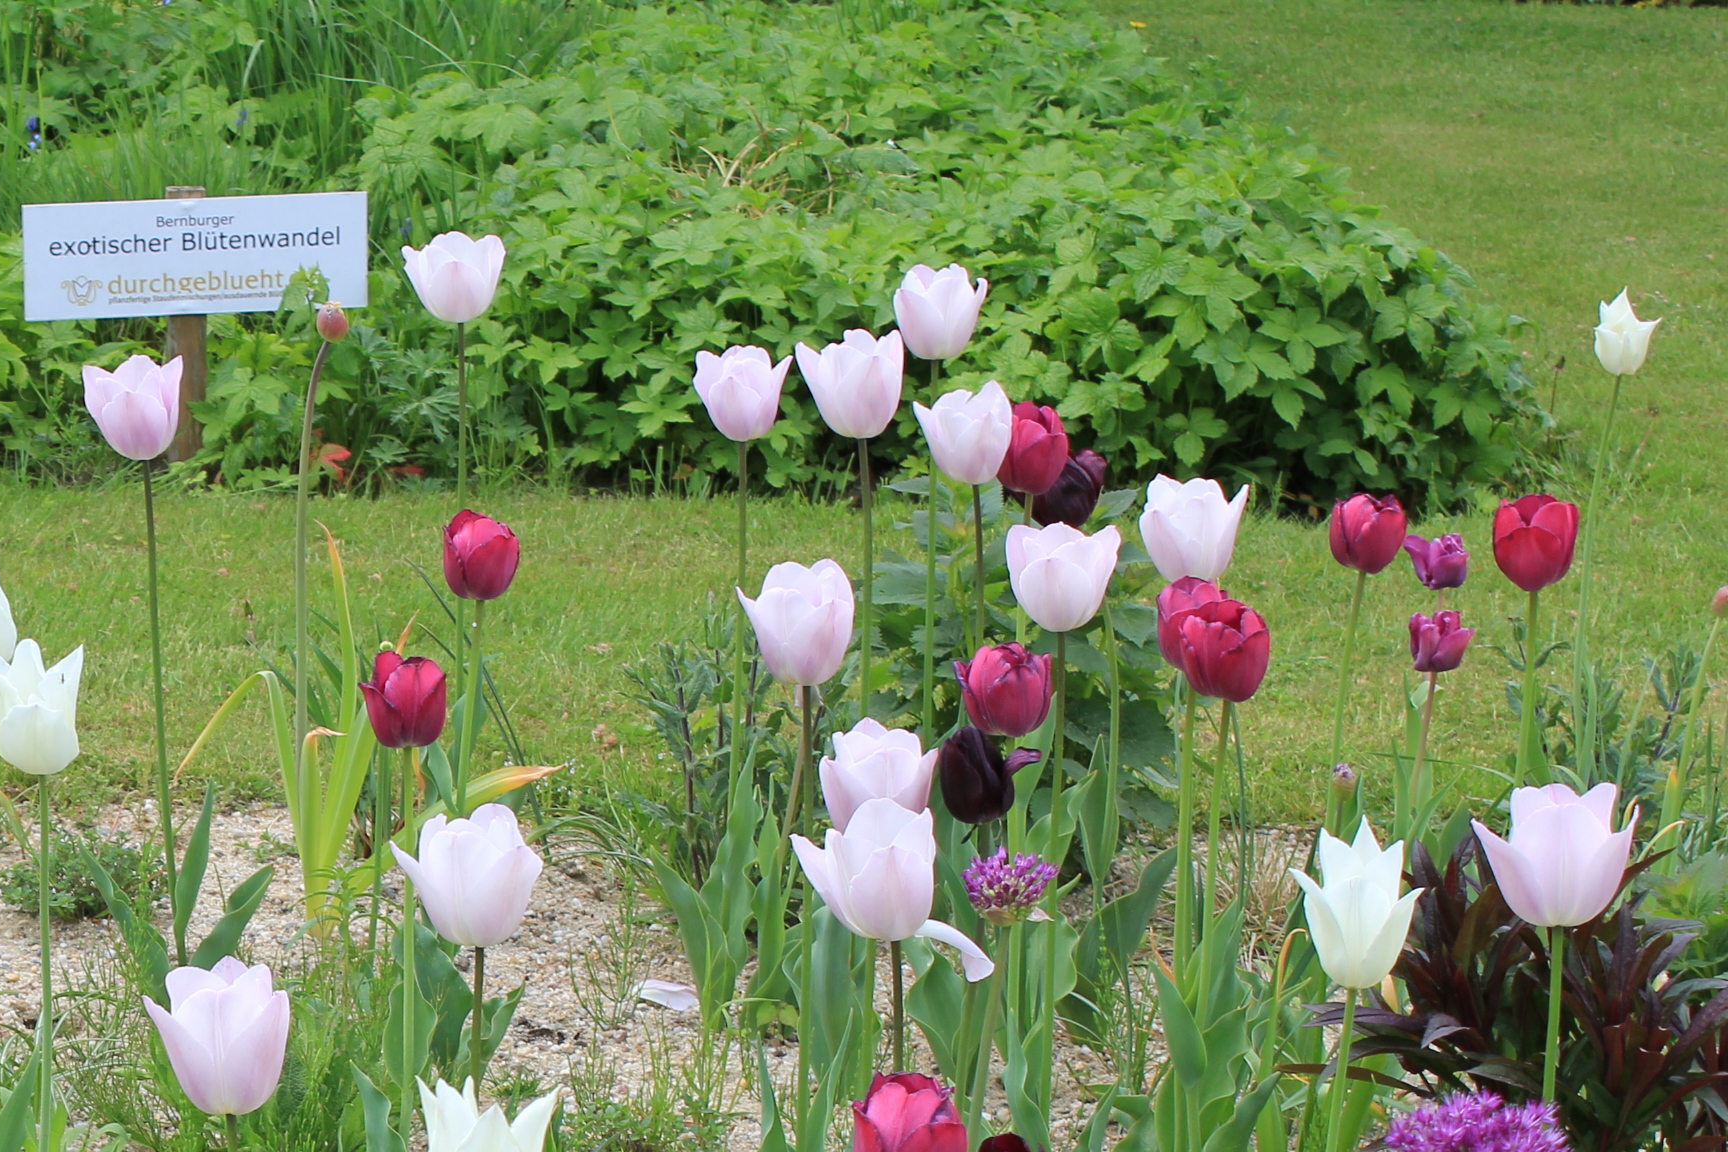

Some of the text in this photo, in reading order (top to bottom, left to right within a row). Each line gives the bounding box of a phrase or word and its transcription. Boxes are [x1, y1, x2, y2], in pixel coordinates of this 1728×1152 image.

[156, 214, 235, 228] Bernburger
[49, 226, 341, 256] exotischer Blütenwandel
